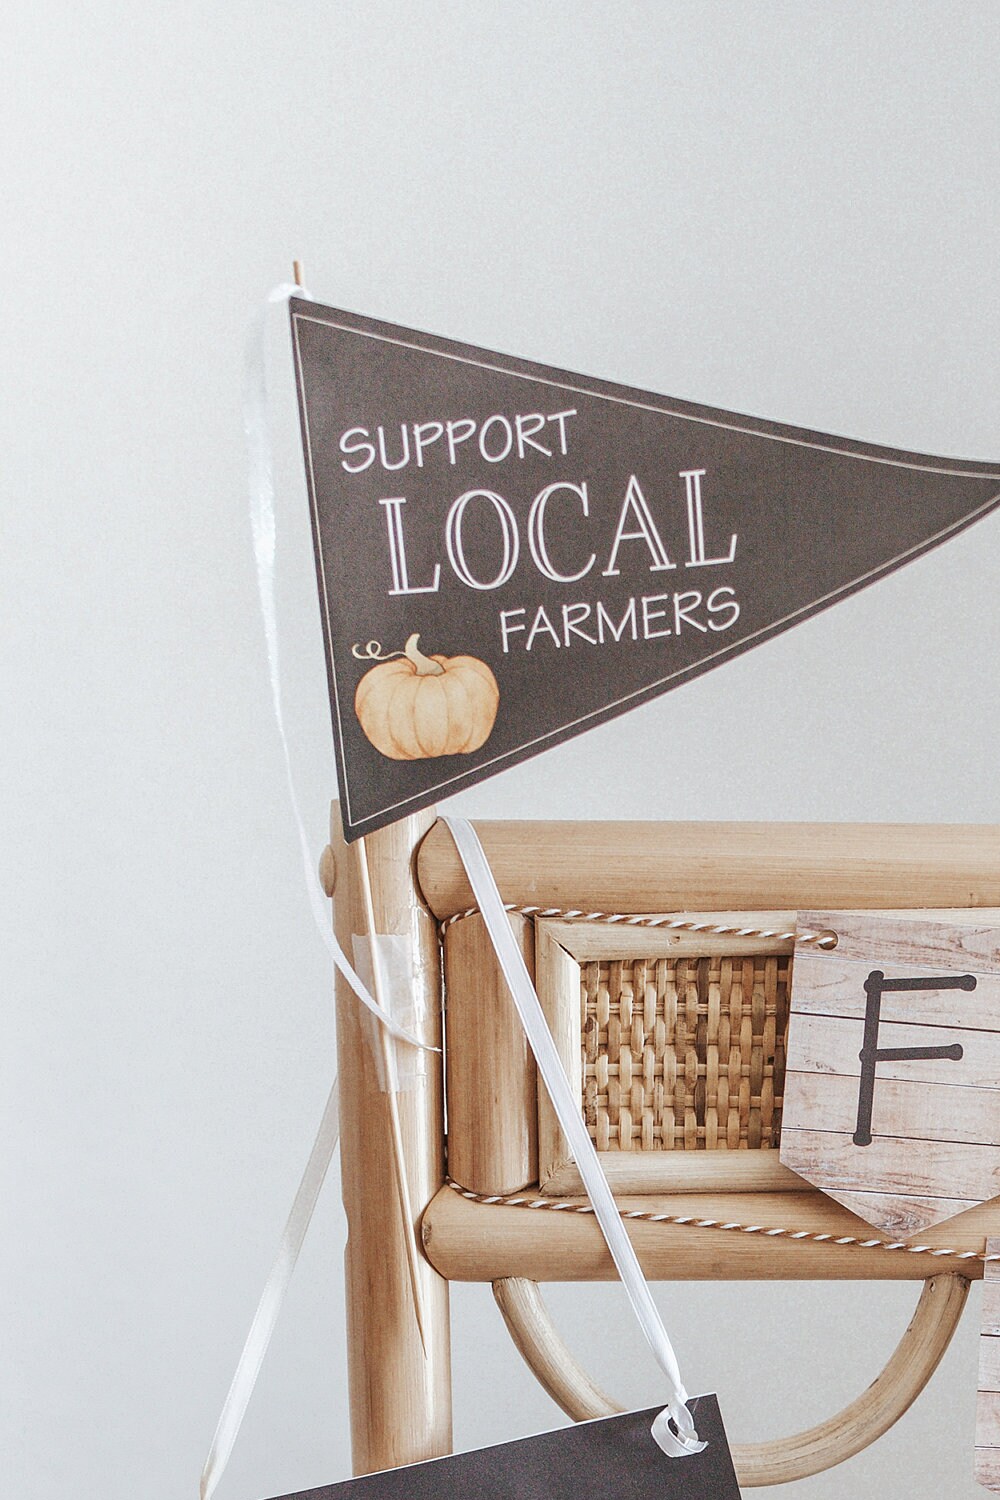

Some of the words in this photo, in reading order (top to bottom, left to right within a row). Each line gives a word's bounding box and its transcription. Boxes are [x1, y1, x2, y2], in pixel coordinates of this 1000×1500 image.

[338, 408, 578, 474] SUPPORT
[377, 468, 738, 596] LOCAL
[499, 587, 741, 654] FARMERS
